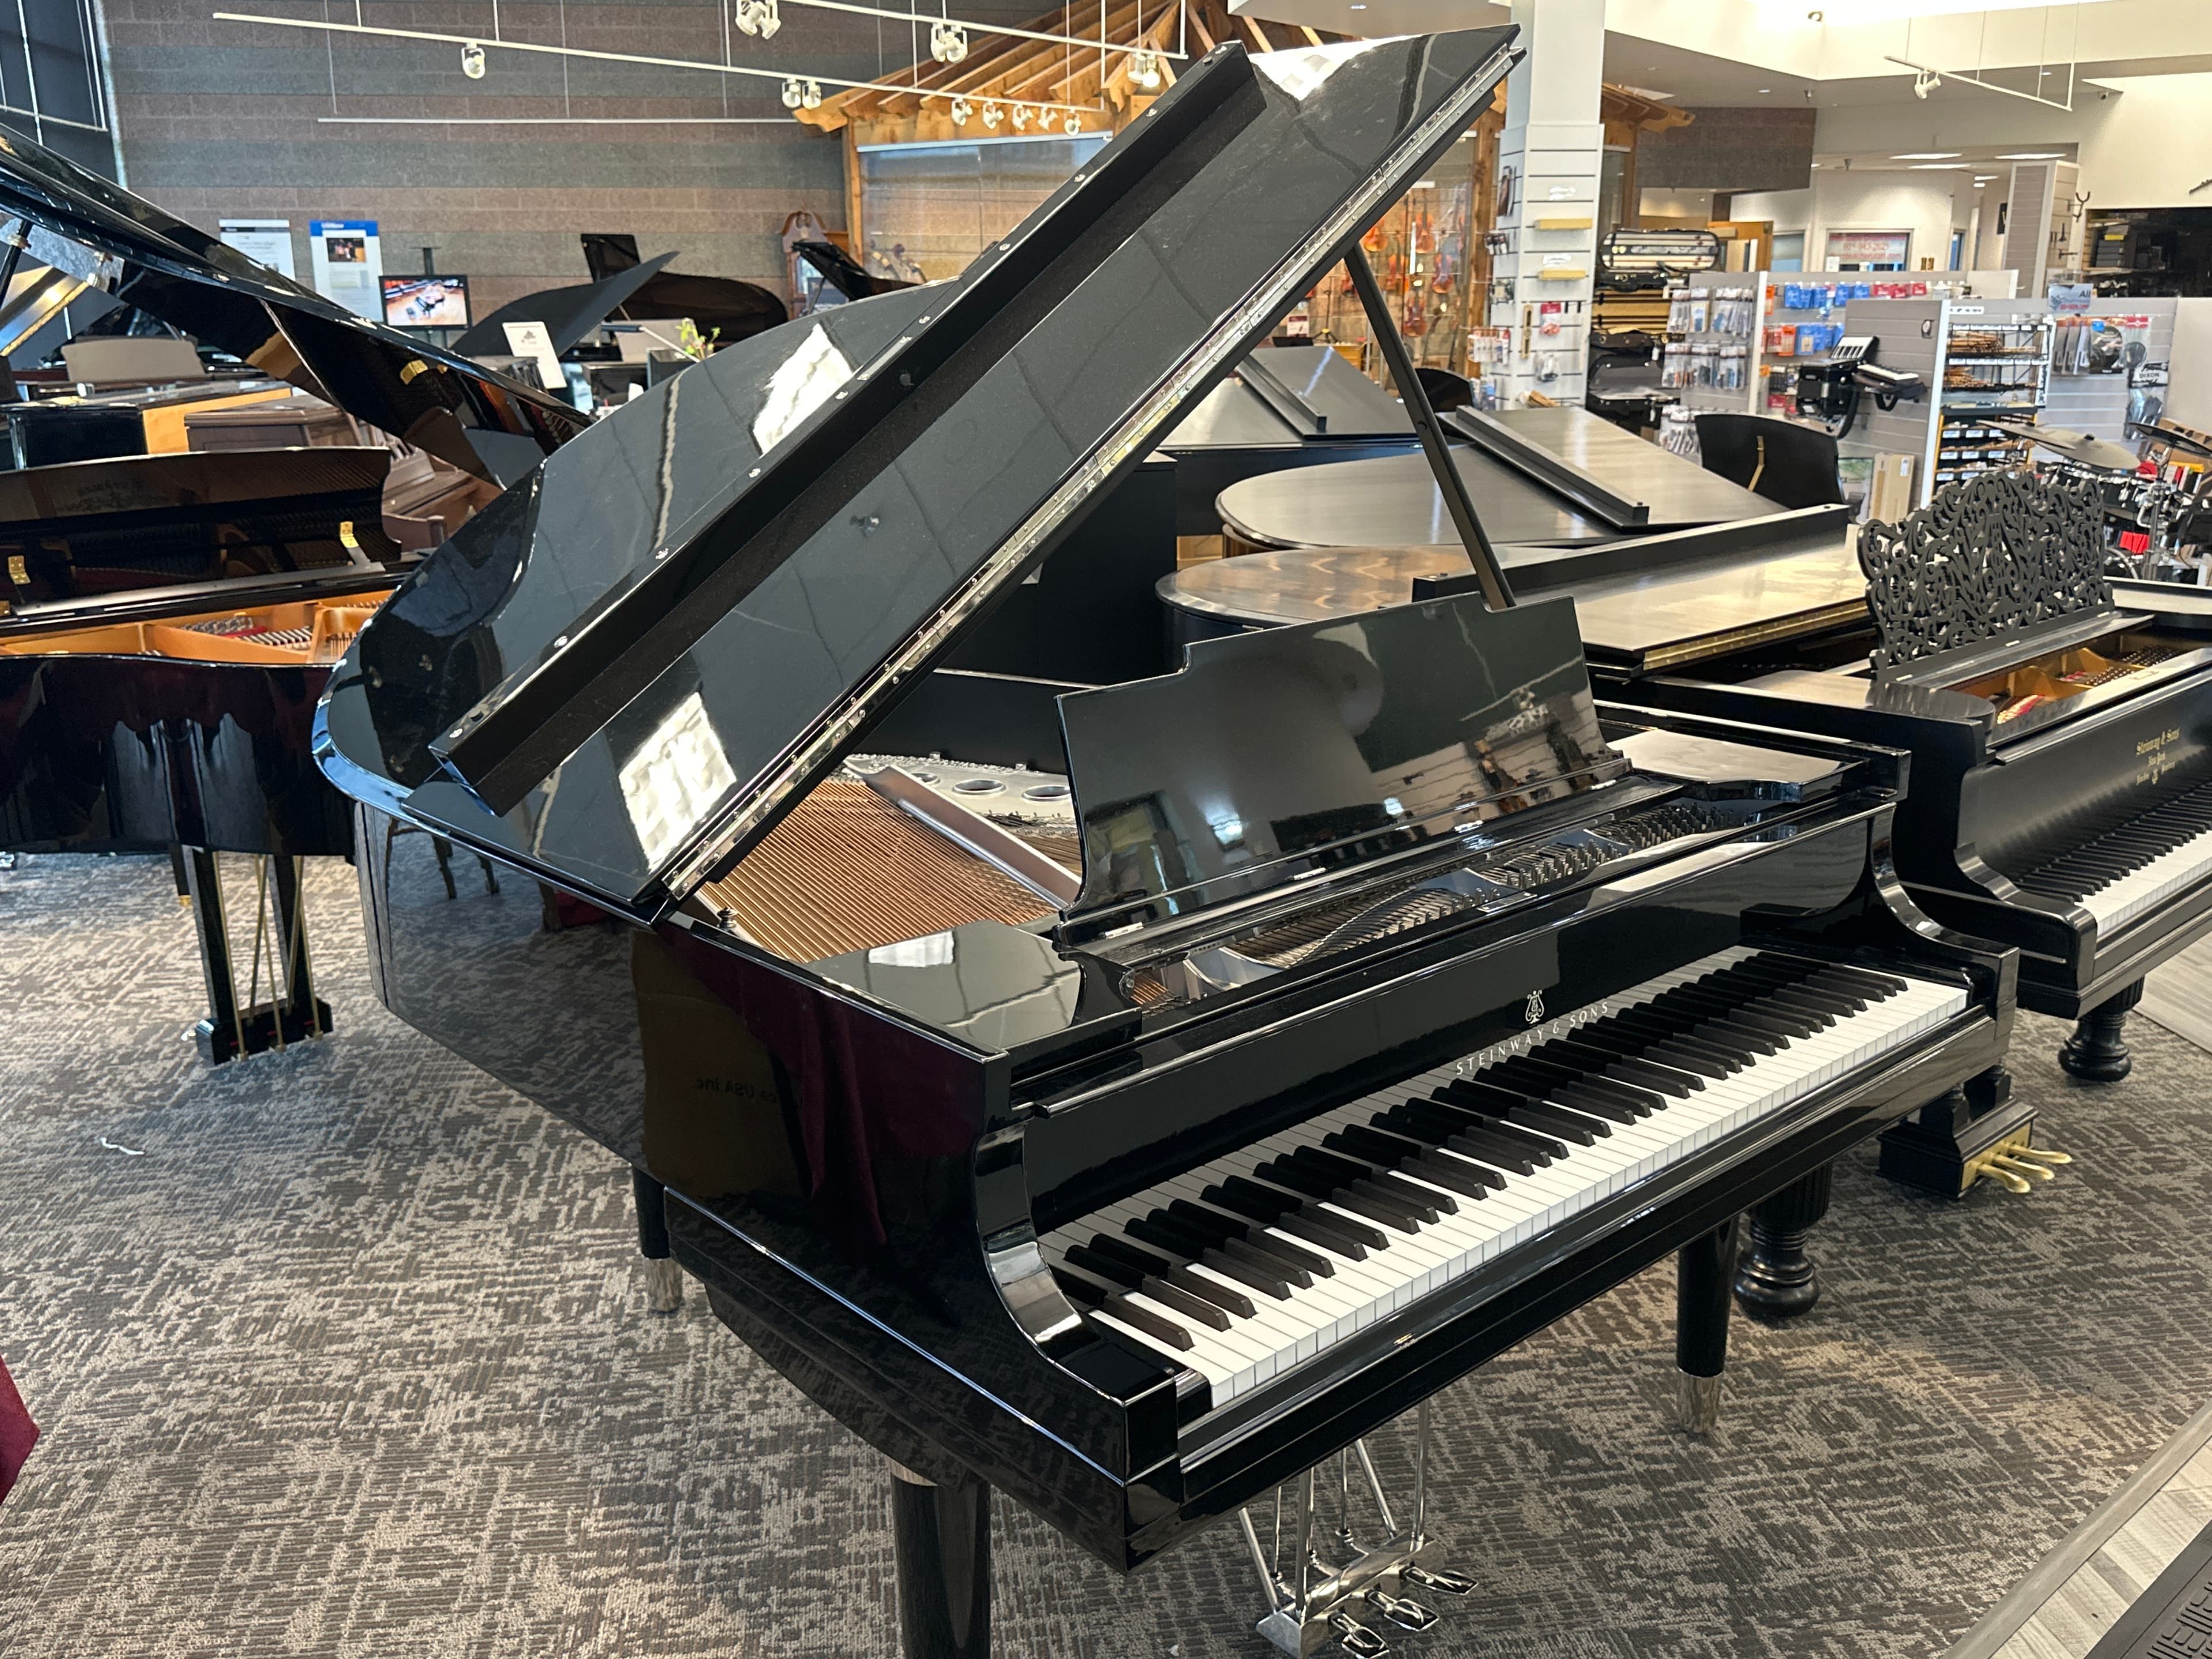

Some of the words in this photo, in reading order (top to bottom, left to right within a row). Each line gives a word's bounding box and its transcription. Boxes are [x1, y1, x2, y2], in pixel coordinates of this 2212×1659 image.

[1456, 1028, 1544, 1075] STEINWAY
[1552, 1021, 1559, 1034] &
[1569, 1001, 1608, 1028] SONS
